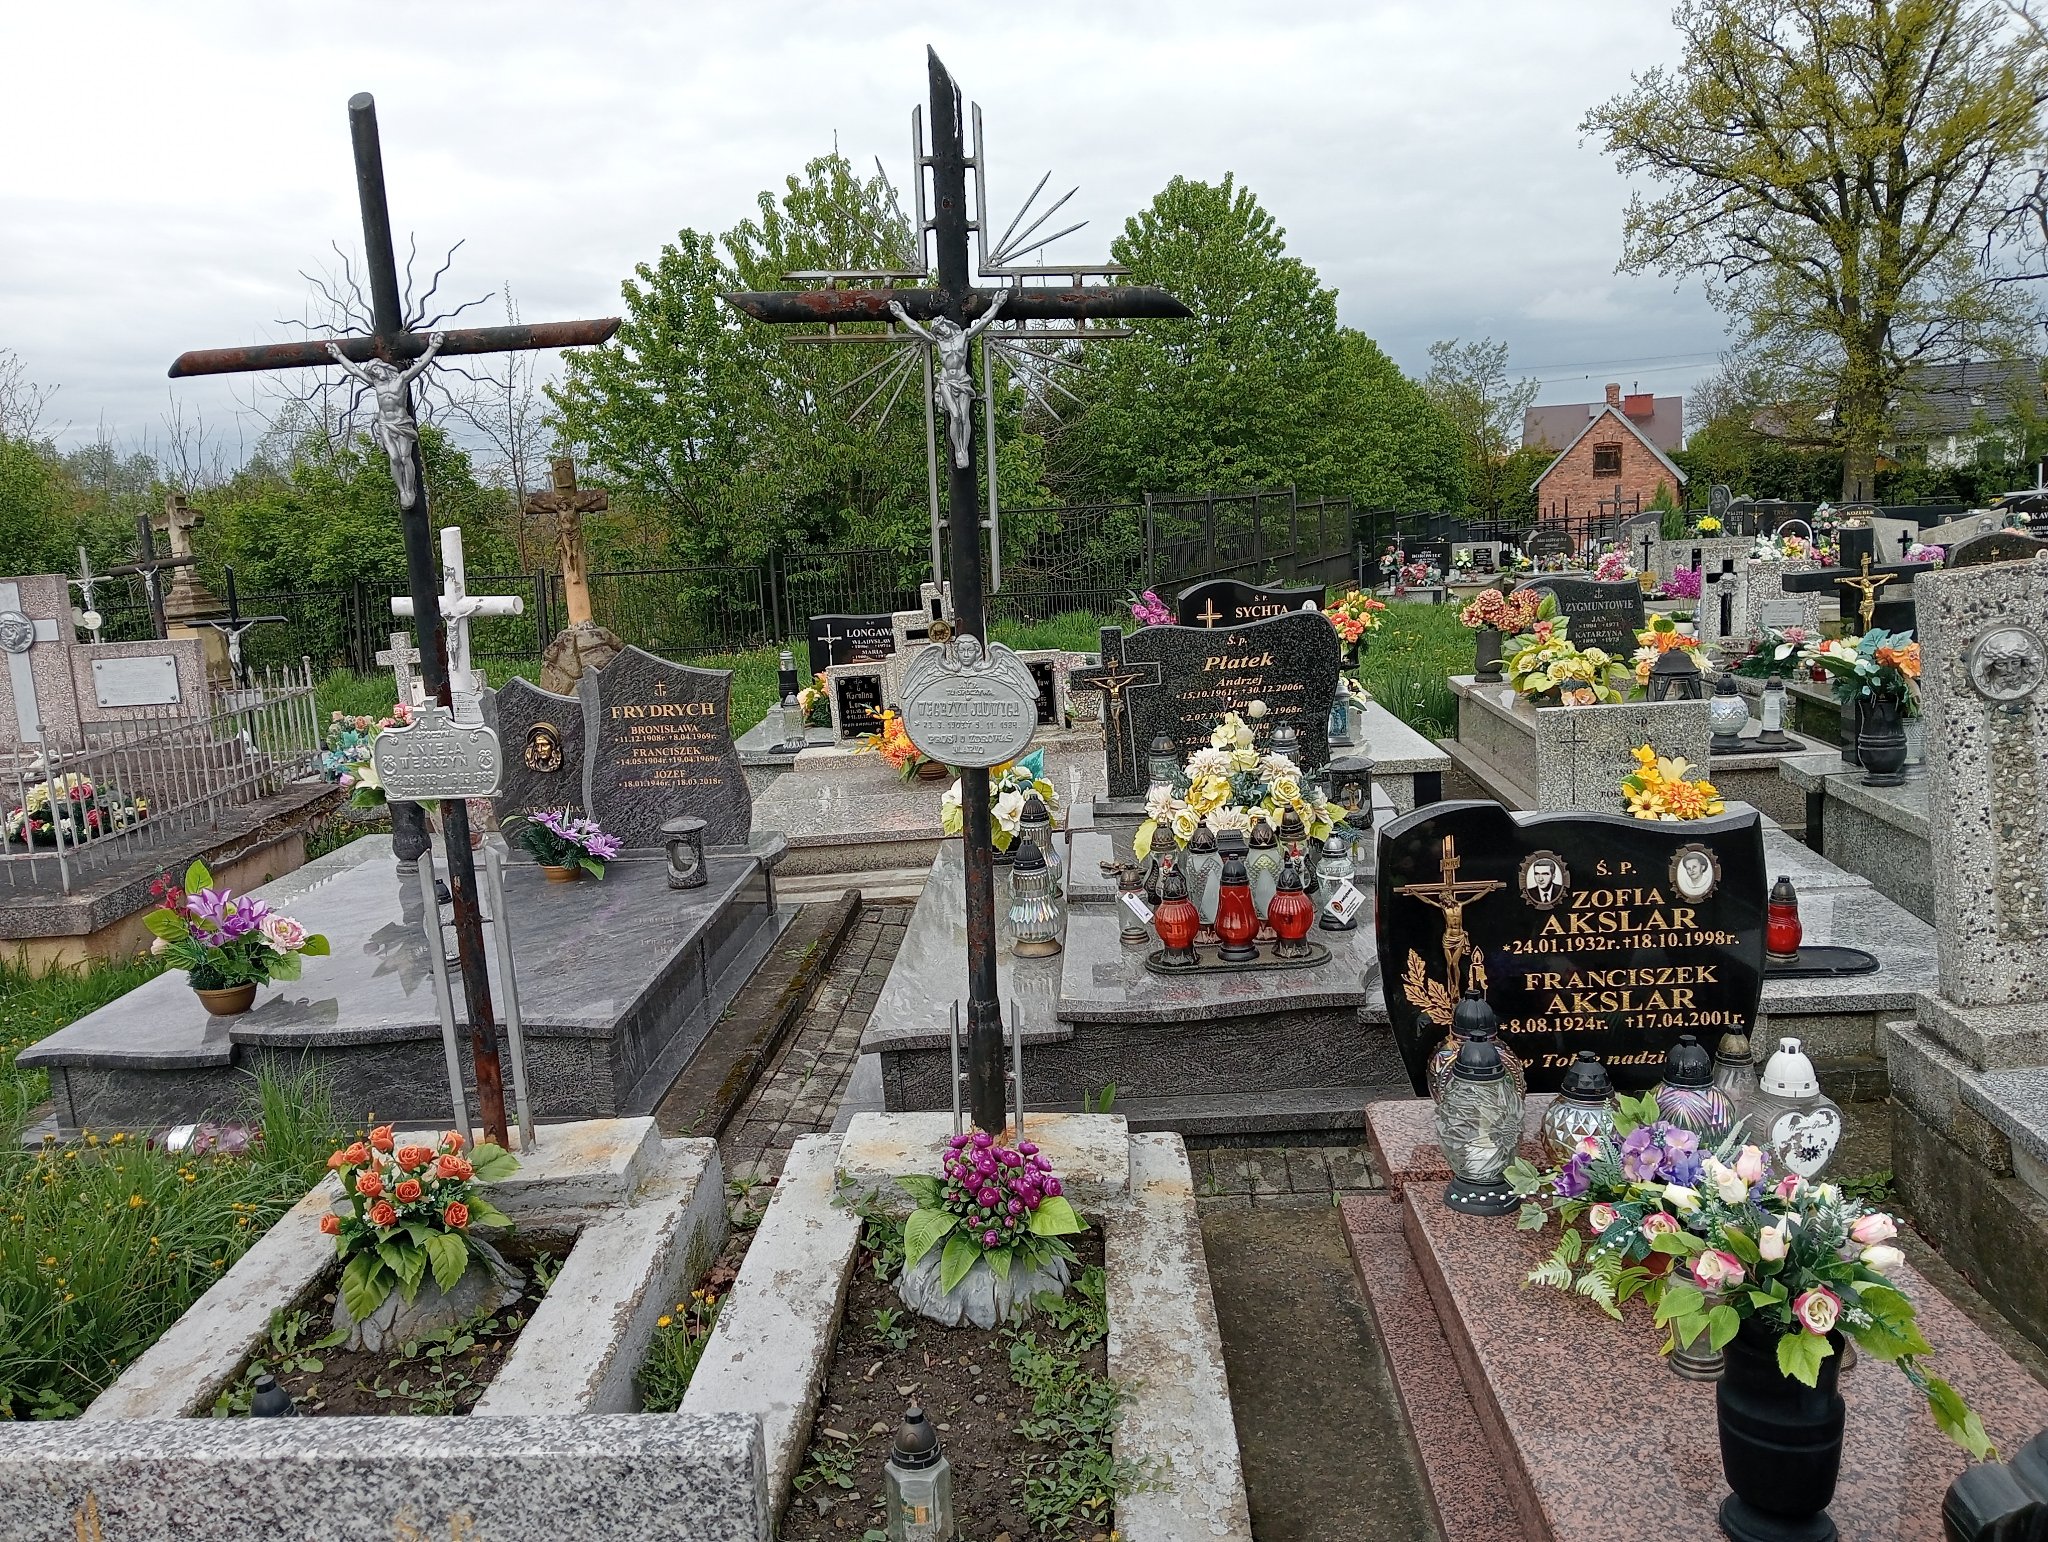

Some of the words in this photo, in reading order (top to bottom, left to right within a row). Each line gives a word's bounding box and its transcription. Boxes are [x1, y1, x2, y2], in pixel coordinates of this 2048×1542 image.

[1235, 605, 1289, 618] SYCHTA
[1565, 600, 1634, 612] ZYGMUNTOWIE
[1591, 615, 1607, 623] JAN
[1575, 630, 1623, 639] KATARZYNA
[1203, 651, 1275, 672] Płatek
[1216, 675, 1263, 688] Andrzej
[1247, 683, 1305, 695] 30.12.2006r.
[610, 702, 715, 719] FRYDRYCH
[917, 701, 968, 718] WĘGRZYN
[970, 701, 1021, 717] JADWIGA
[631, 723, 699, 735] BRONISŁAWA
[405, 741, 465, 758] ANIELA
[633, 746, 701, 757] FRANCISZEK
[400, 754, 469, 771] WĘGRZYN
[653, 769, 686, 779] JÓZEF
[1596, 859, 1613, 876] Ś.
[1620, 861, 1637, 875] P.
[1571, 888, 1665, 909] ZOFIA
[1540, 908, 1699, 936] AKSLAR
[1512, 937, 1621, 955] 24.01.1932r.
[1632, 930, 1741, 950] 18.10.1998r.
[1524, 965, 1718, 991] FRANCISZEK
[1545, 988, 1697, 1015] AKSLAR
[1510, 1015, 1609, 1034] 8.08.1924r.
[1636, 1010, 1745, 1029] 17.04.2001r.
